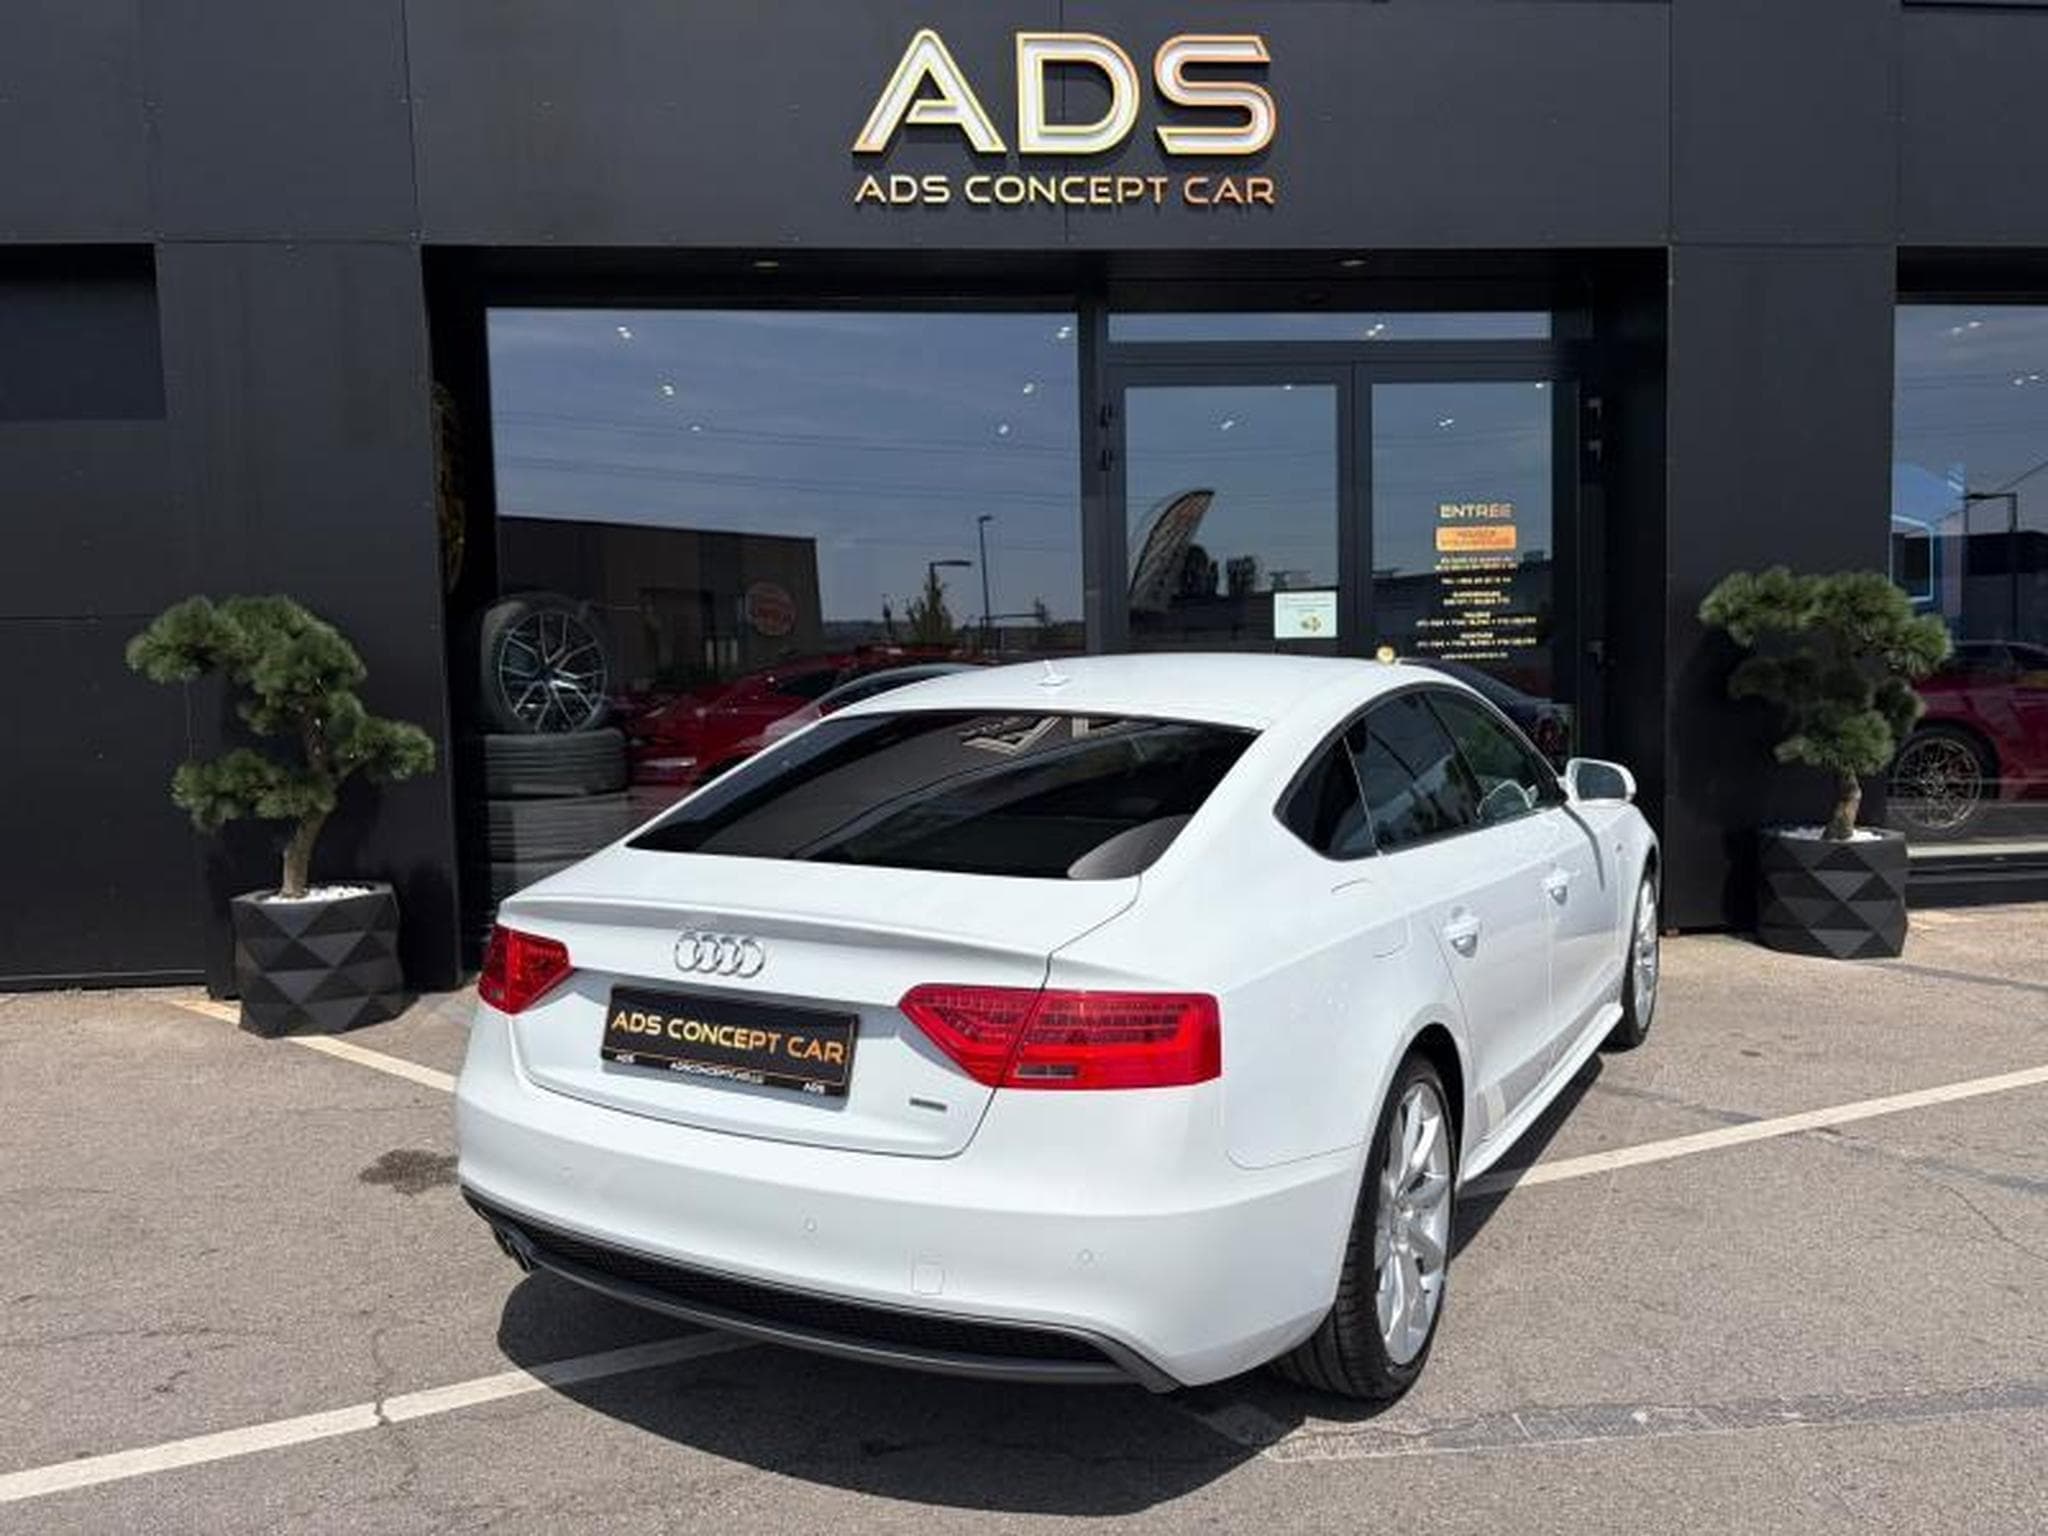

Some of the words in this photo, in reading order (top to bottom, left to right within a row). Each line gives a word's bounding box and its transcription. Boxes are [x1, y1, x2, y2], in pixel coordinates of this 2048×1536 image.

[851, 28, 1277, 155] ADS
[854, 175, 951, 203] ADS
[964, 175, 1169, 204] CONCEPT
[1183, 175, 1277, 204] CAR
[611, 1010, 663, 1037] ADS
[667, 1018, 782, 1054] CONCEPT
[787, 1036, 846, 1066] CAR
